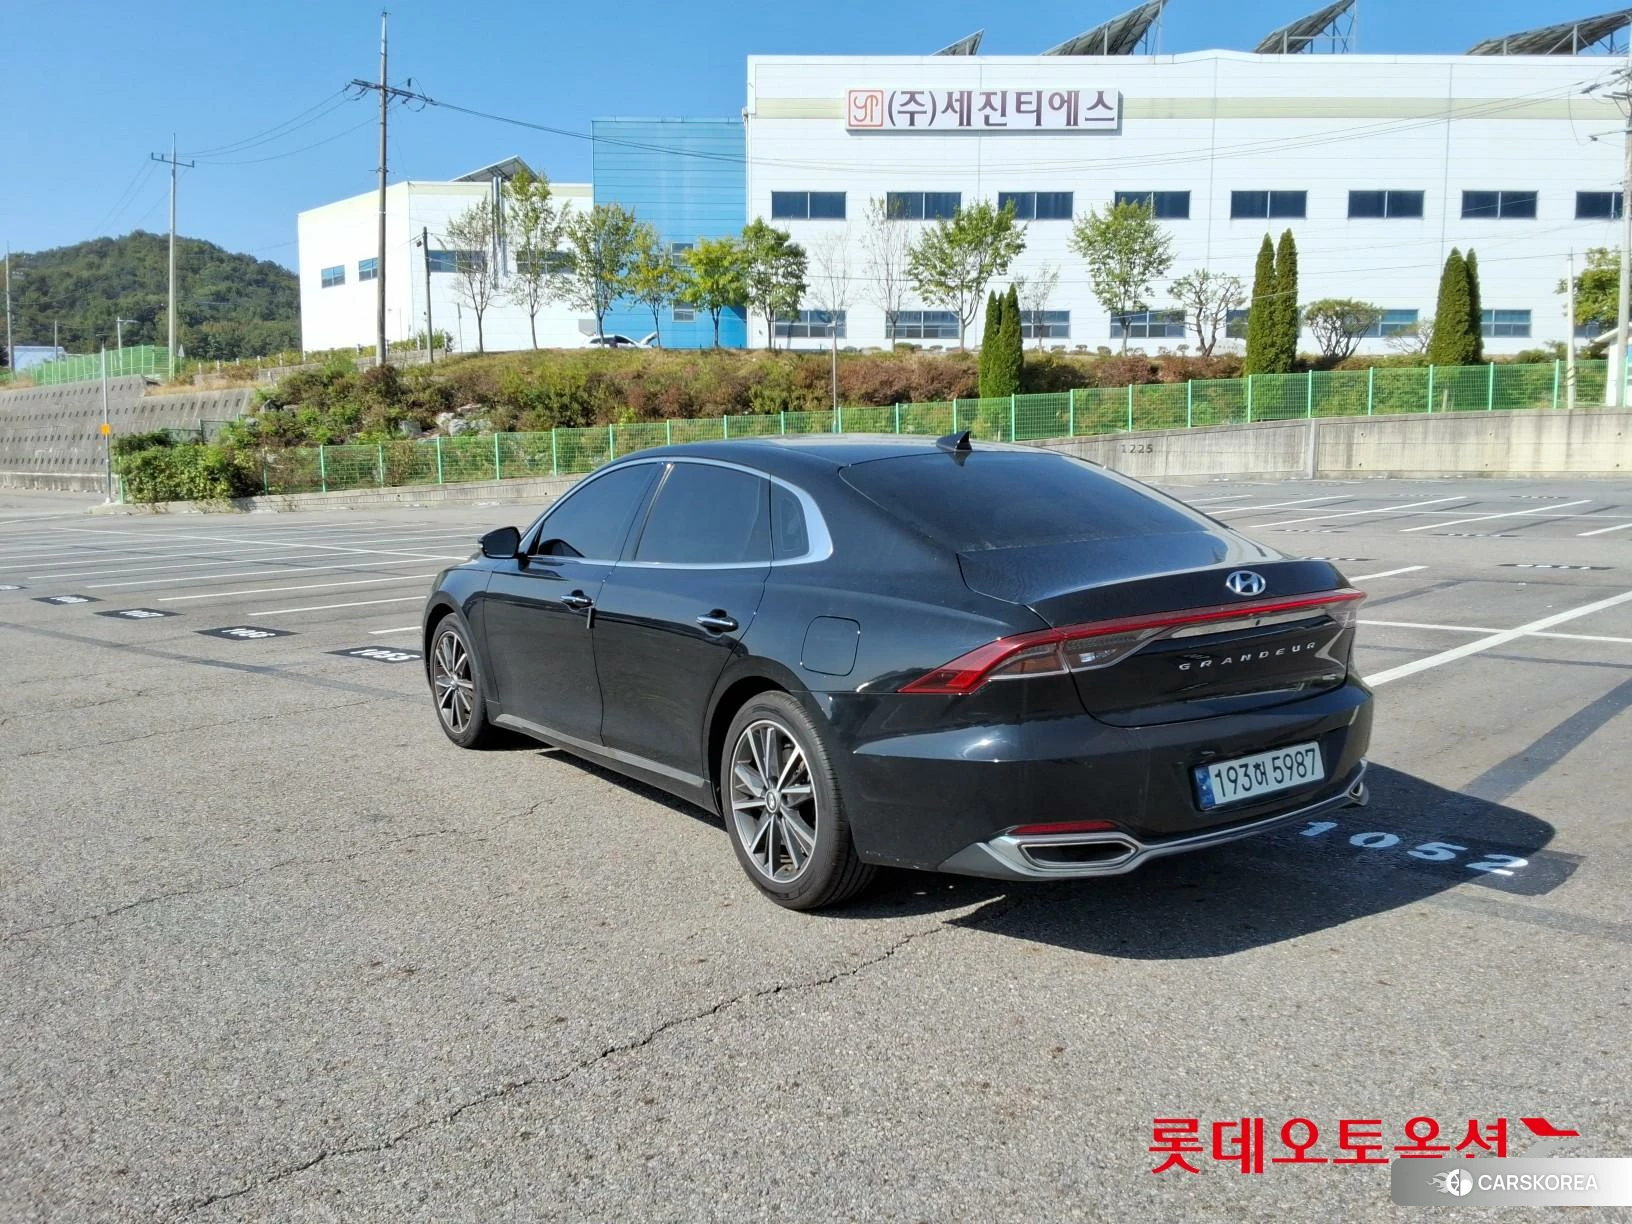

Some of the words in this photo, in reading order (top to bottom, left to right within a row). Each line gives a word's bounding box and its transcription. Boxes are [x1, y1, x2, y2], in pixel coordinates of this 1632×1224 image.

[887, 90, 1115, 127] (주)세진티에스
[1178, 641, 1316, 671] GRANDEUR
[1271, 747, 1316, 785] 5987
[1299, 821, 1529, 876] 1052
